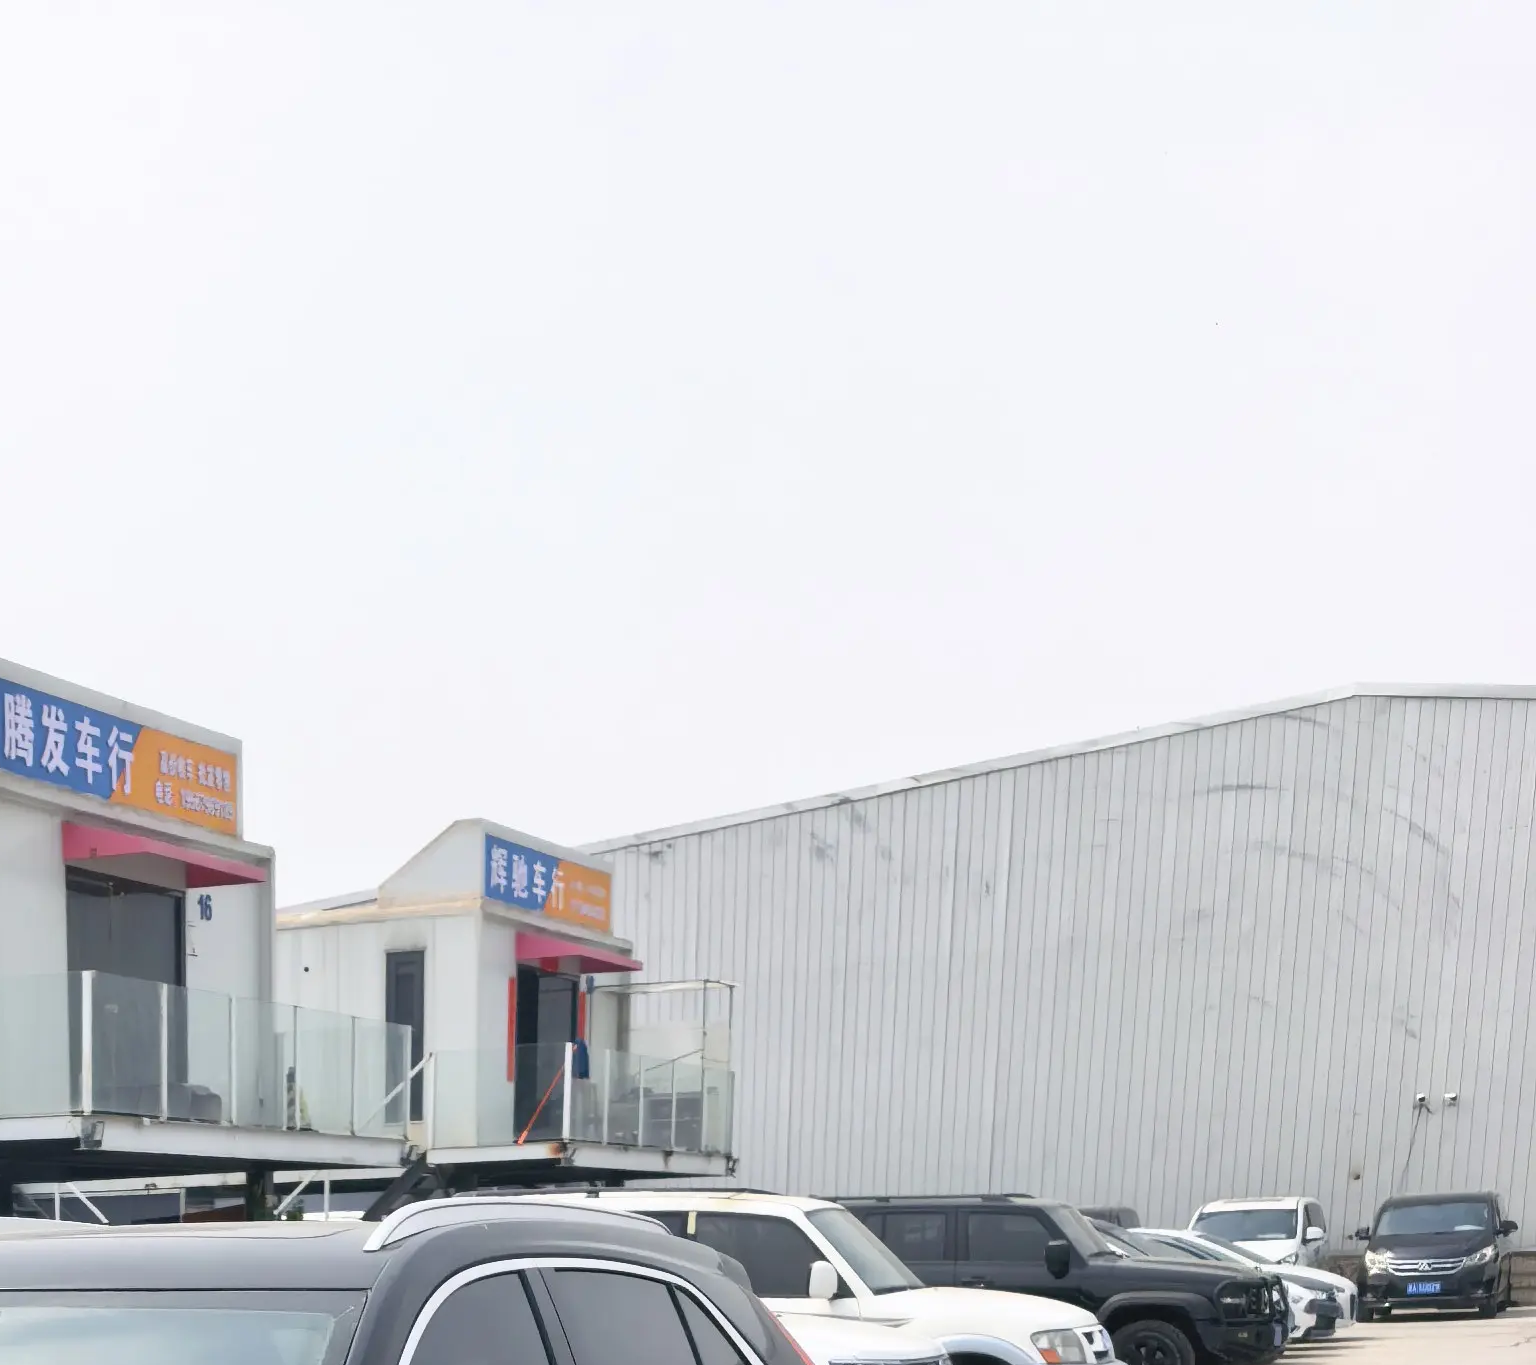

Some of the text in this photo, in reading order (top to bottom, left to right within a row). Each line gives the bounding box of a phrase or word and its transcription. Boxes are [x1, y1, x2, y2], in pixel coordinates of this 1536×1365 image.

[4, 694, 134, 795] 腾发车行
[197, 894, 213, 921] 16
